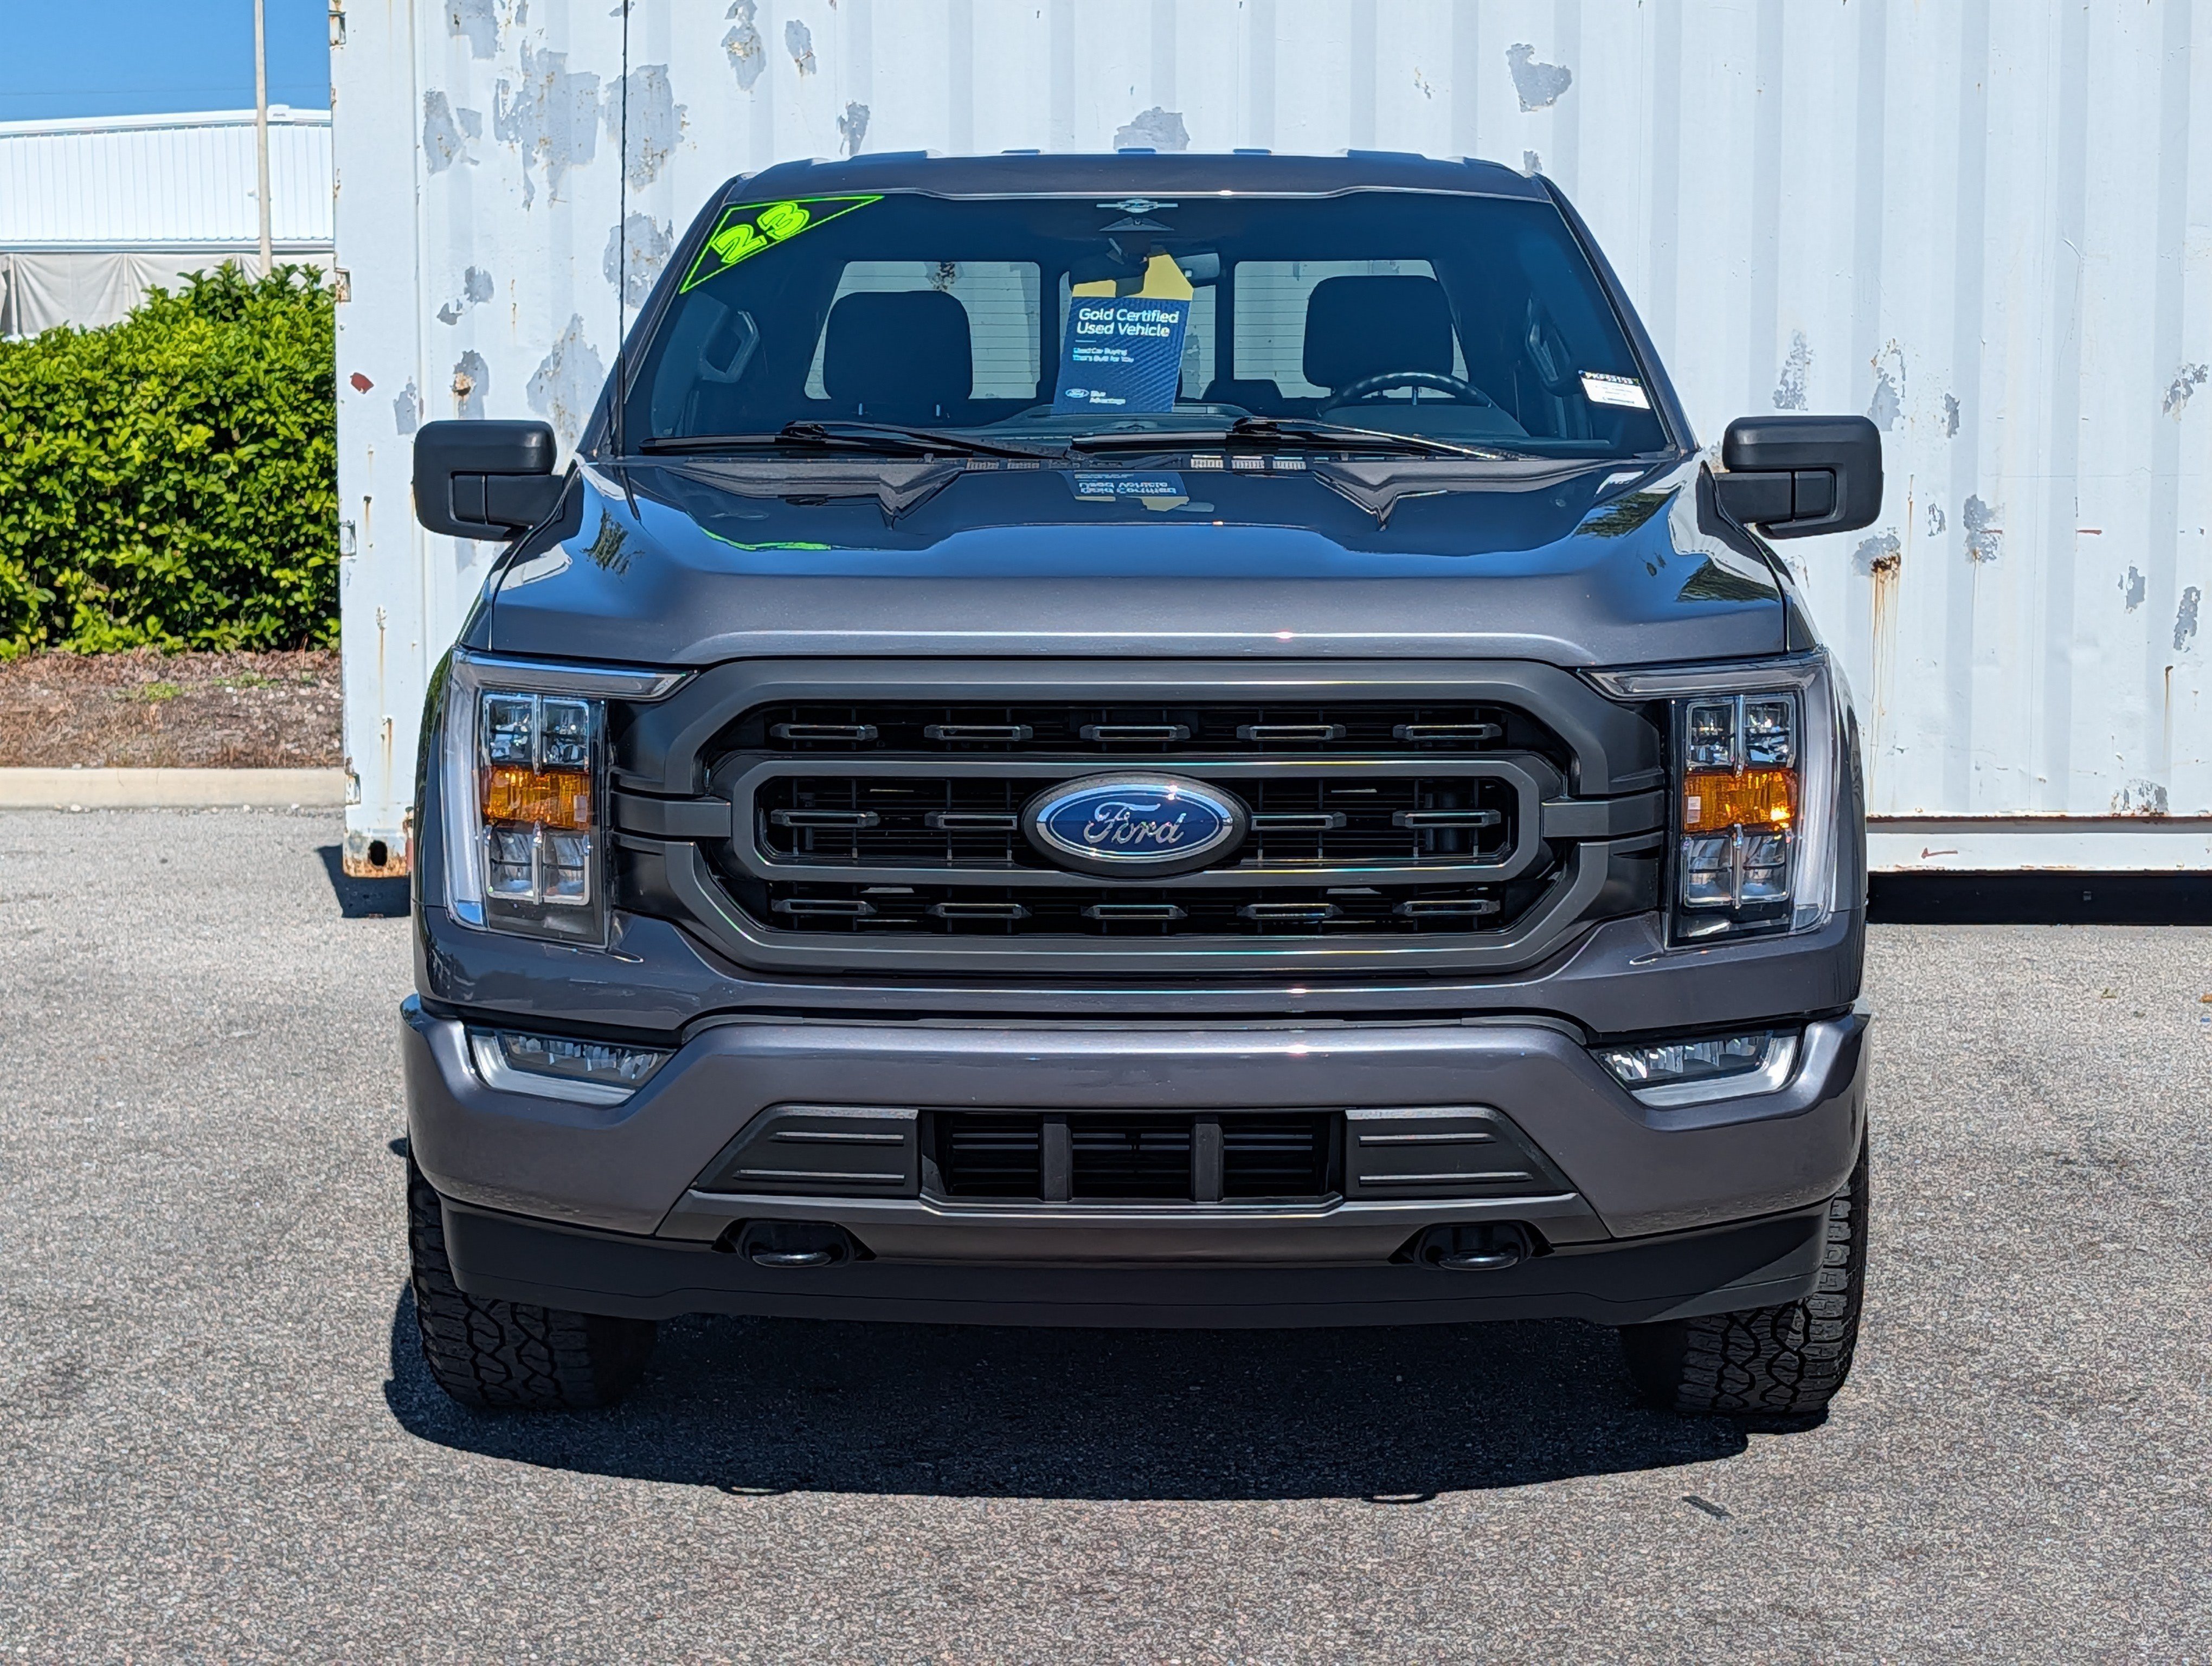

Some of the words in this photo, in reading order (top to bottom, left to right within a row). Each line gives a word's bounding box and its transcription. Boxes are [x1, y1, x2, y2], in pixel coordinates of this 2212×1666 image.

[711, 201, 809, 264] 23
[1077, 321, 1115, 334] Used
[1118, 323, 1170, 337] Vehicle
[1079, 308, 1115, 321] Gold
[1116, 309, 1180, 323] Certified
[1084, 802, 1185, 844] Ford
